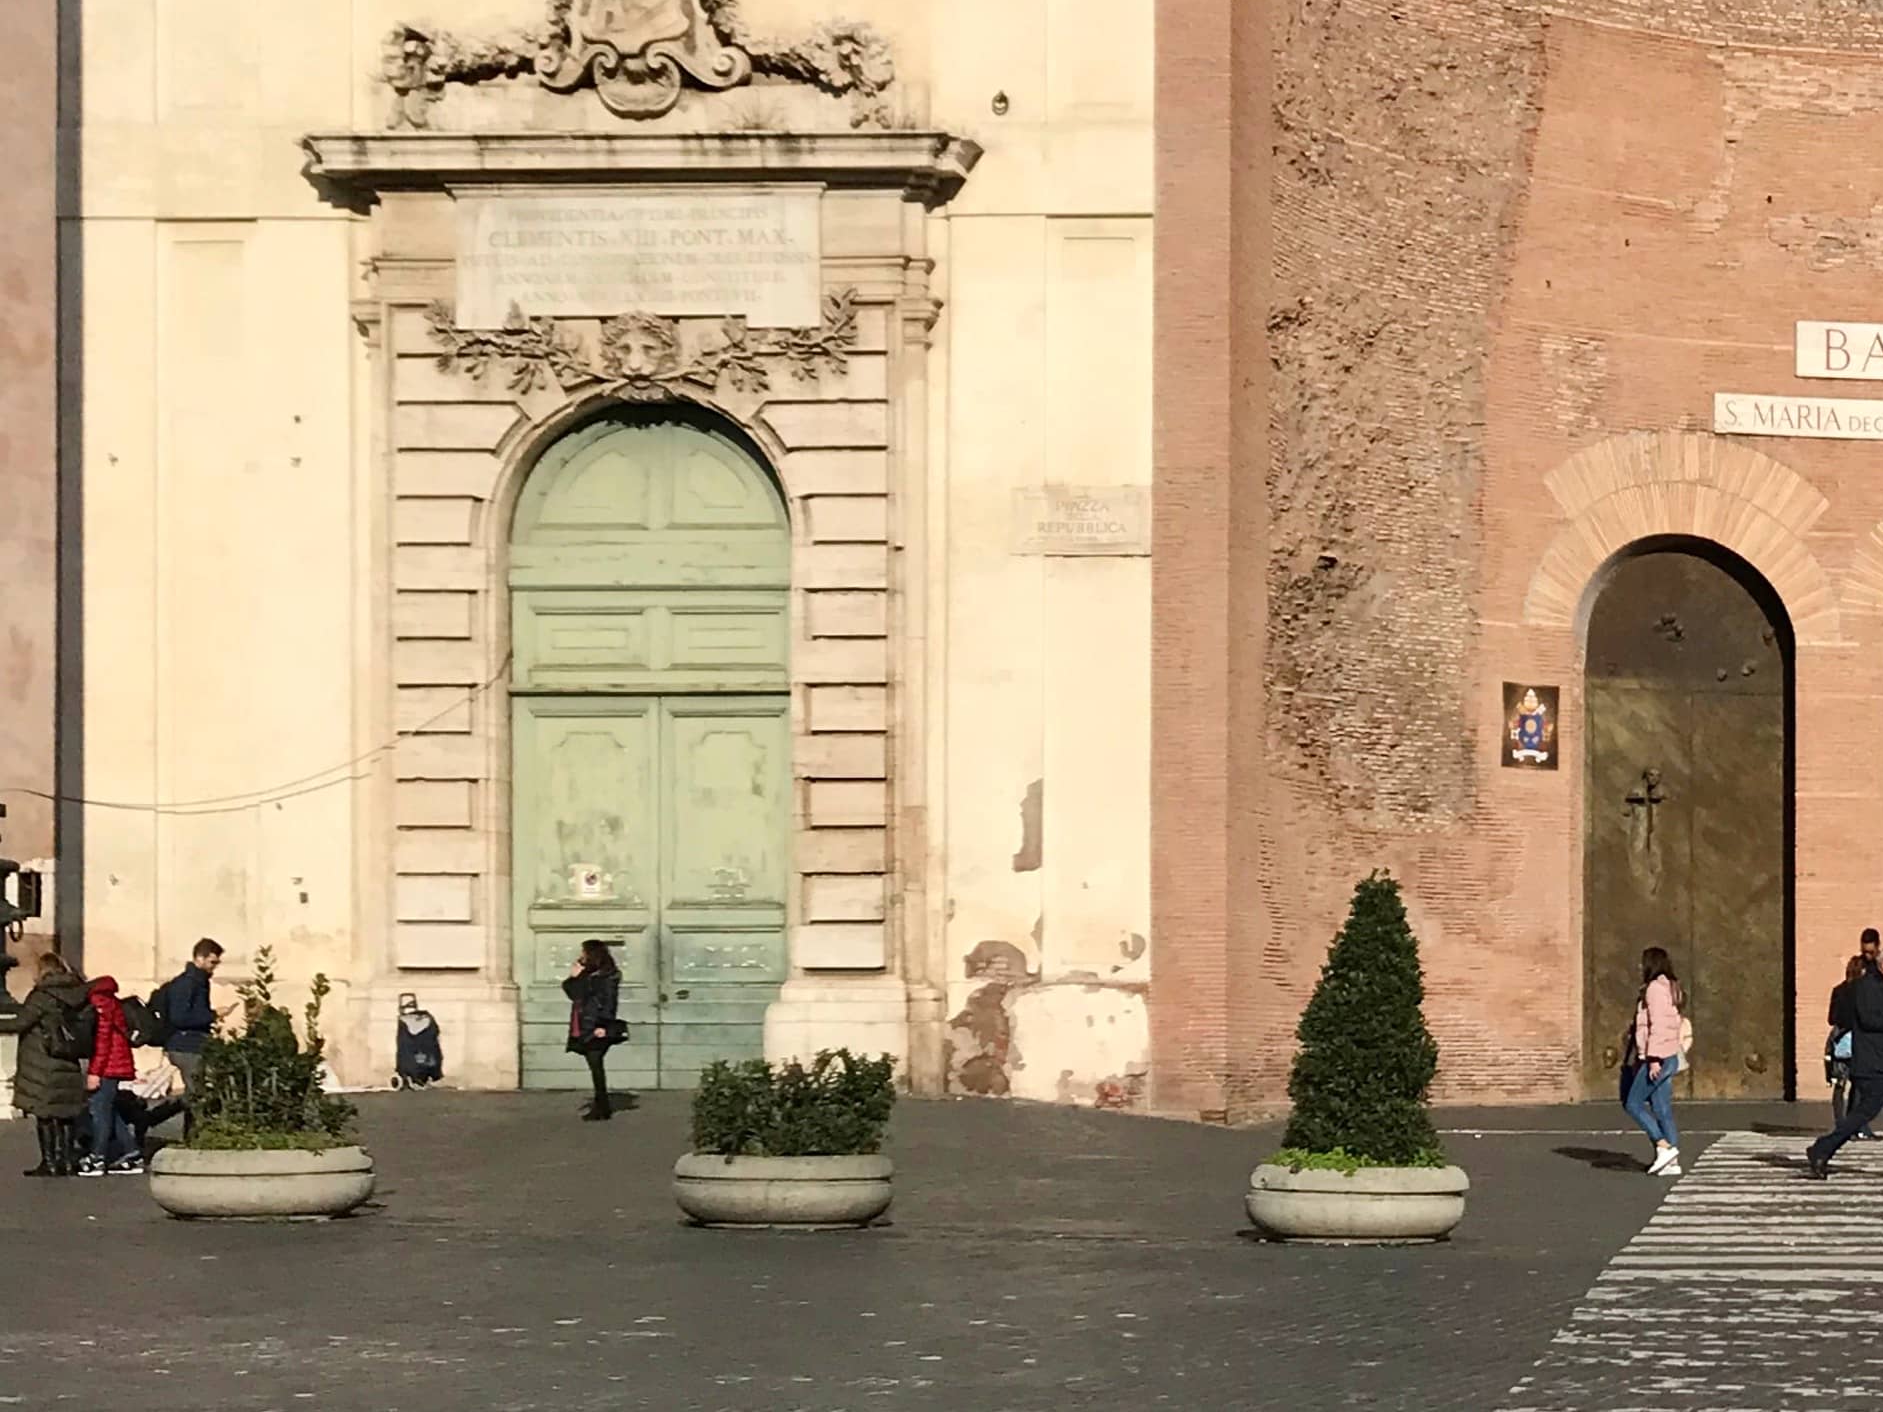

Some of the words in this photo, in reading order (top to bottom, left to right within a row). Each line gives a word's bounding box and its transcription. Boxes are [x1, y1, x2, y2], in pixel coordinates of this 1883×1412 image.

[1723, 399, 1743, 427] S.
[1753, 401, 1842, 432] MARIA
[1055, 499, 1110, 512] PIAZZA
[1037, 521, 1128, 534] REPUBBLICA
